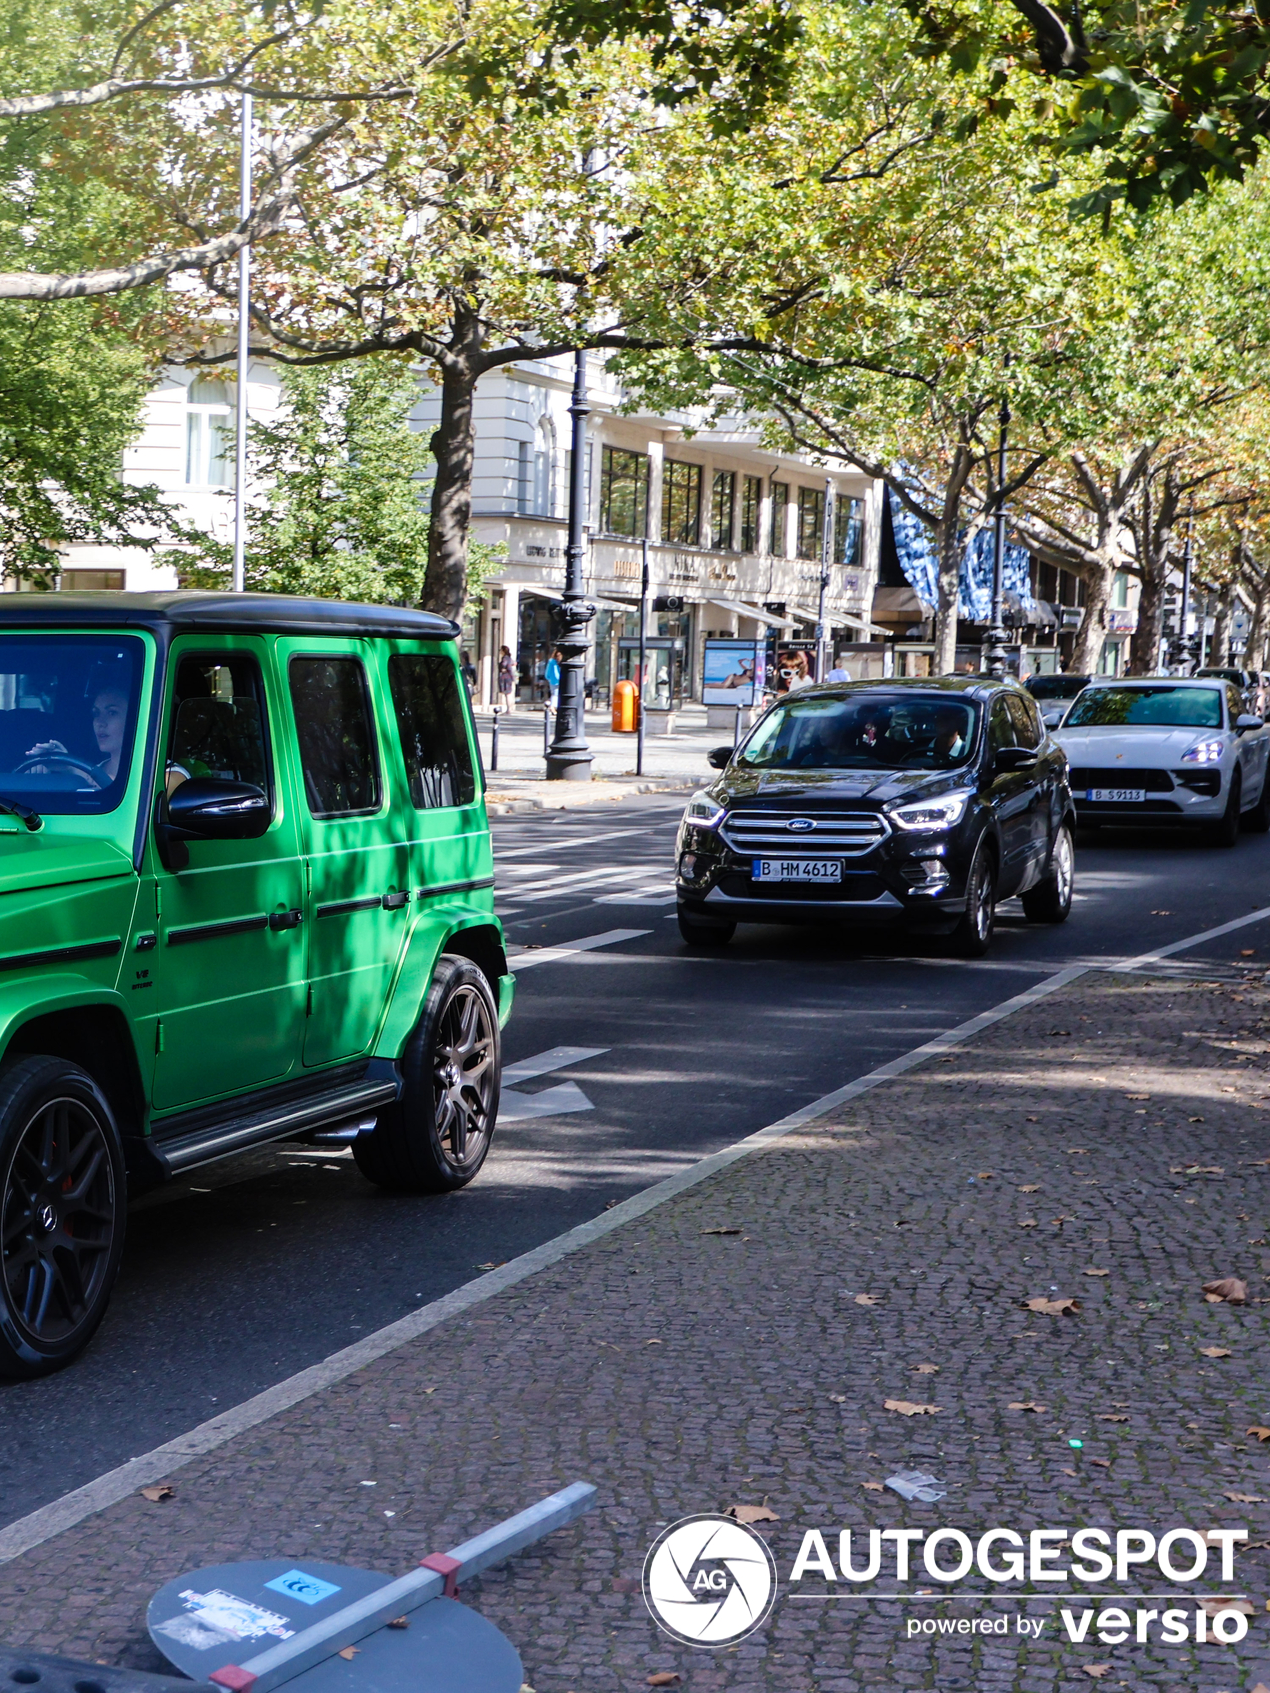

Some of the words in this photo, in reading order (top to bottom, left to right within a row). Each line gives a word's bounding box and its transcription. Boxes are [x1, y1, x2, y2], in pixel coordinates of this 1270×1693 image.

[1095, 790, 1102, 800] B
[1108, 790, 1115, 800] S
[1116, 790, 1141, 800] 9113
[762, 862, 771, 876] B
[780, 862, 800, 877] HM
[803, 863, 839, 877] 4612
[136, 969, 149, 979] V8
